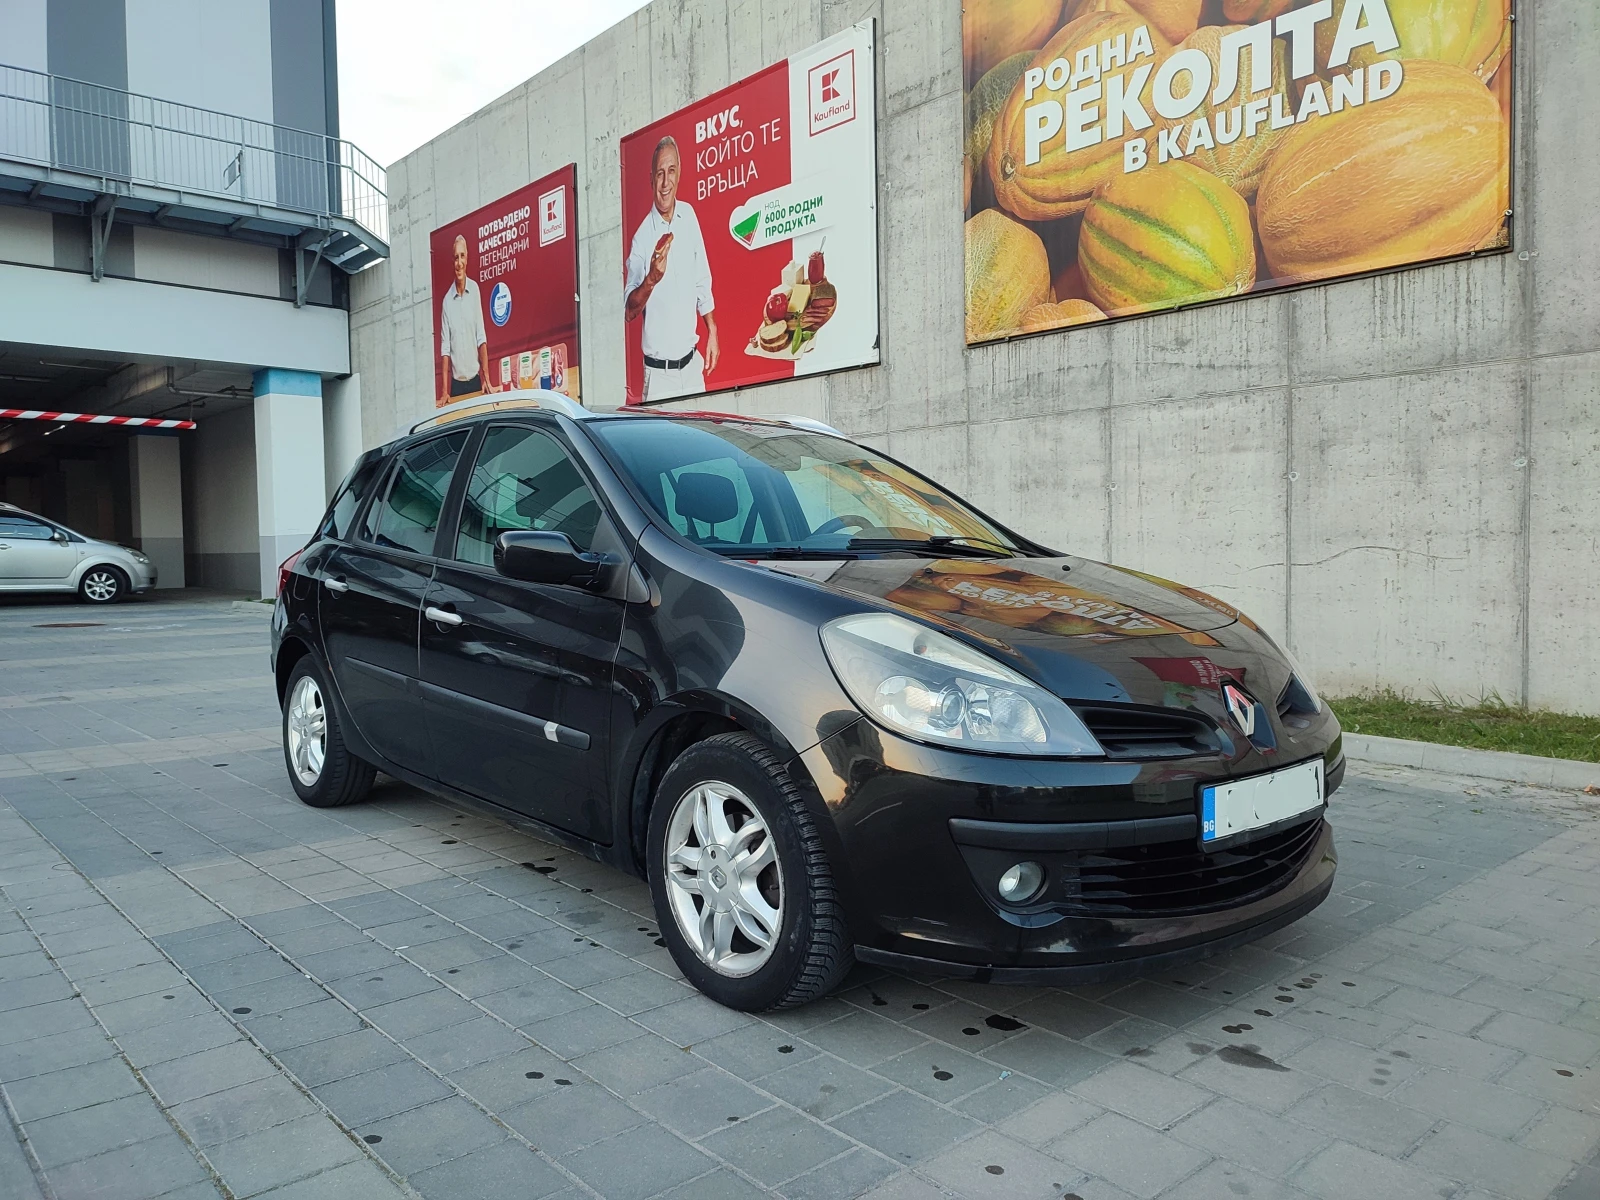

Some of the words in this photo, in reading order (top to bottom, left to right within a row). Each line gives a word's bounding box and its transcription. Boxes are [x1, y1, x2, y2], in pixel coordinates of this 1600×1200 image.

[1025, 25, 1154, 100] РОДНА
[1025, 0, 1400, 166] РЕКОЛТА
[695, 104, 743, 144] ВКУС,
[814, 99, 850, 123] Kaufland
[1124, 137, 1148, 173] В
[1158, 59, 1404, 163] KAUFLAND
[696, 131, 755, 173] КОЙТО
[759, 117, 781, 145] ТЕ
[697, 159, 759, 201] ВРЪЩА
[478, 205, 531, 239] ПОТВЪРДЕНО
[764, 208, 786, 224] 6000
[788, 195, 823, 217] РОДНИ
[765, 213, 816, 238] ПРОДУКТА
[478, 227, 518, 254] КАЧЕСТВО
[518, 221, 530, 236] ОТ
[479, 237, 530, 268] ЛЕГЕНДАРНИ
[479, 258, 517, 283] ЕКСПЕРТИ
[1203, 820, 1215, 832] BG
